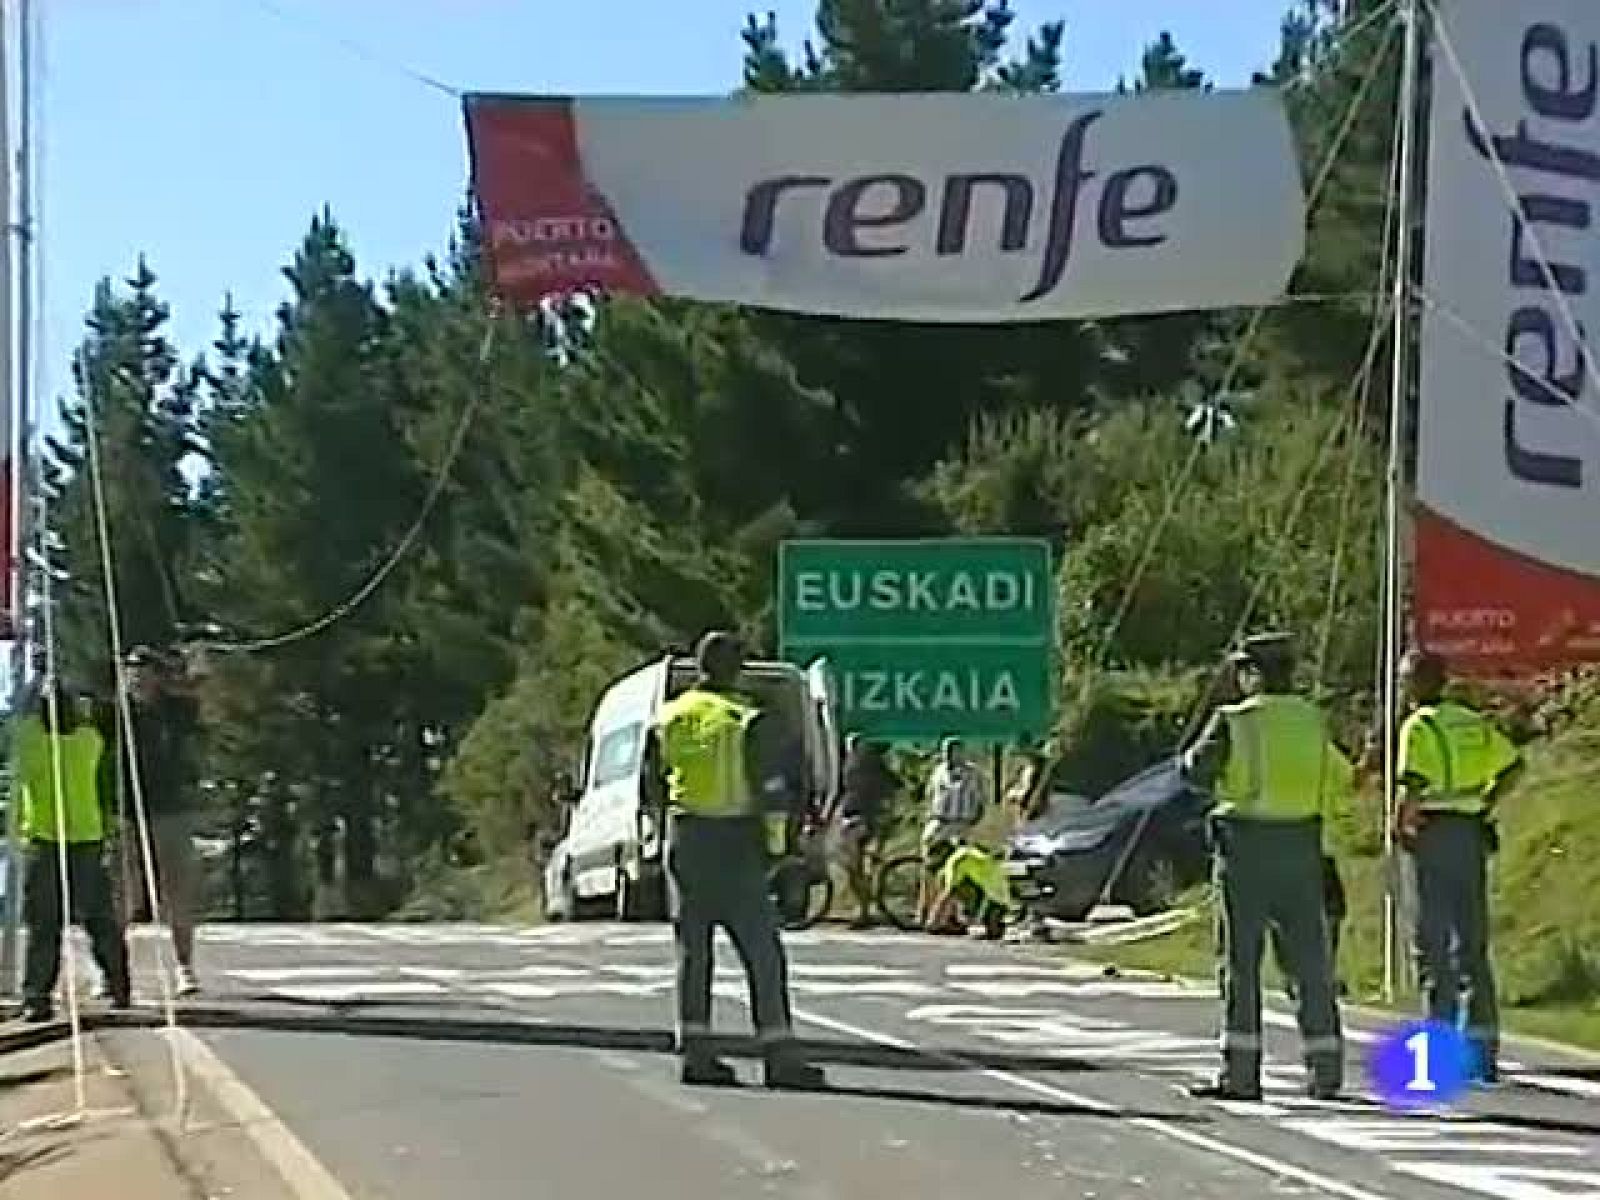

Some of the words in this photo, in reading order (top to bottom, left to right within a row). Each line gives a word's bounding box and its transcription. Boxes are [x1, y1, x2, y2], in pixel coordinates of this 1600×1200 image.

[739, 109, 1178, 302] renfe
[1464, 21, 1600, 488] renfe
[796, 571, 1034, 610] EUSKADI
[828, 671, 1020, 712] IZKAIA
